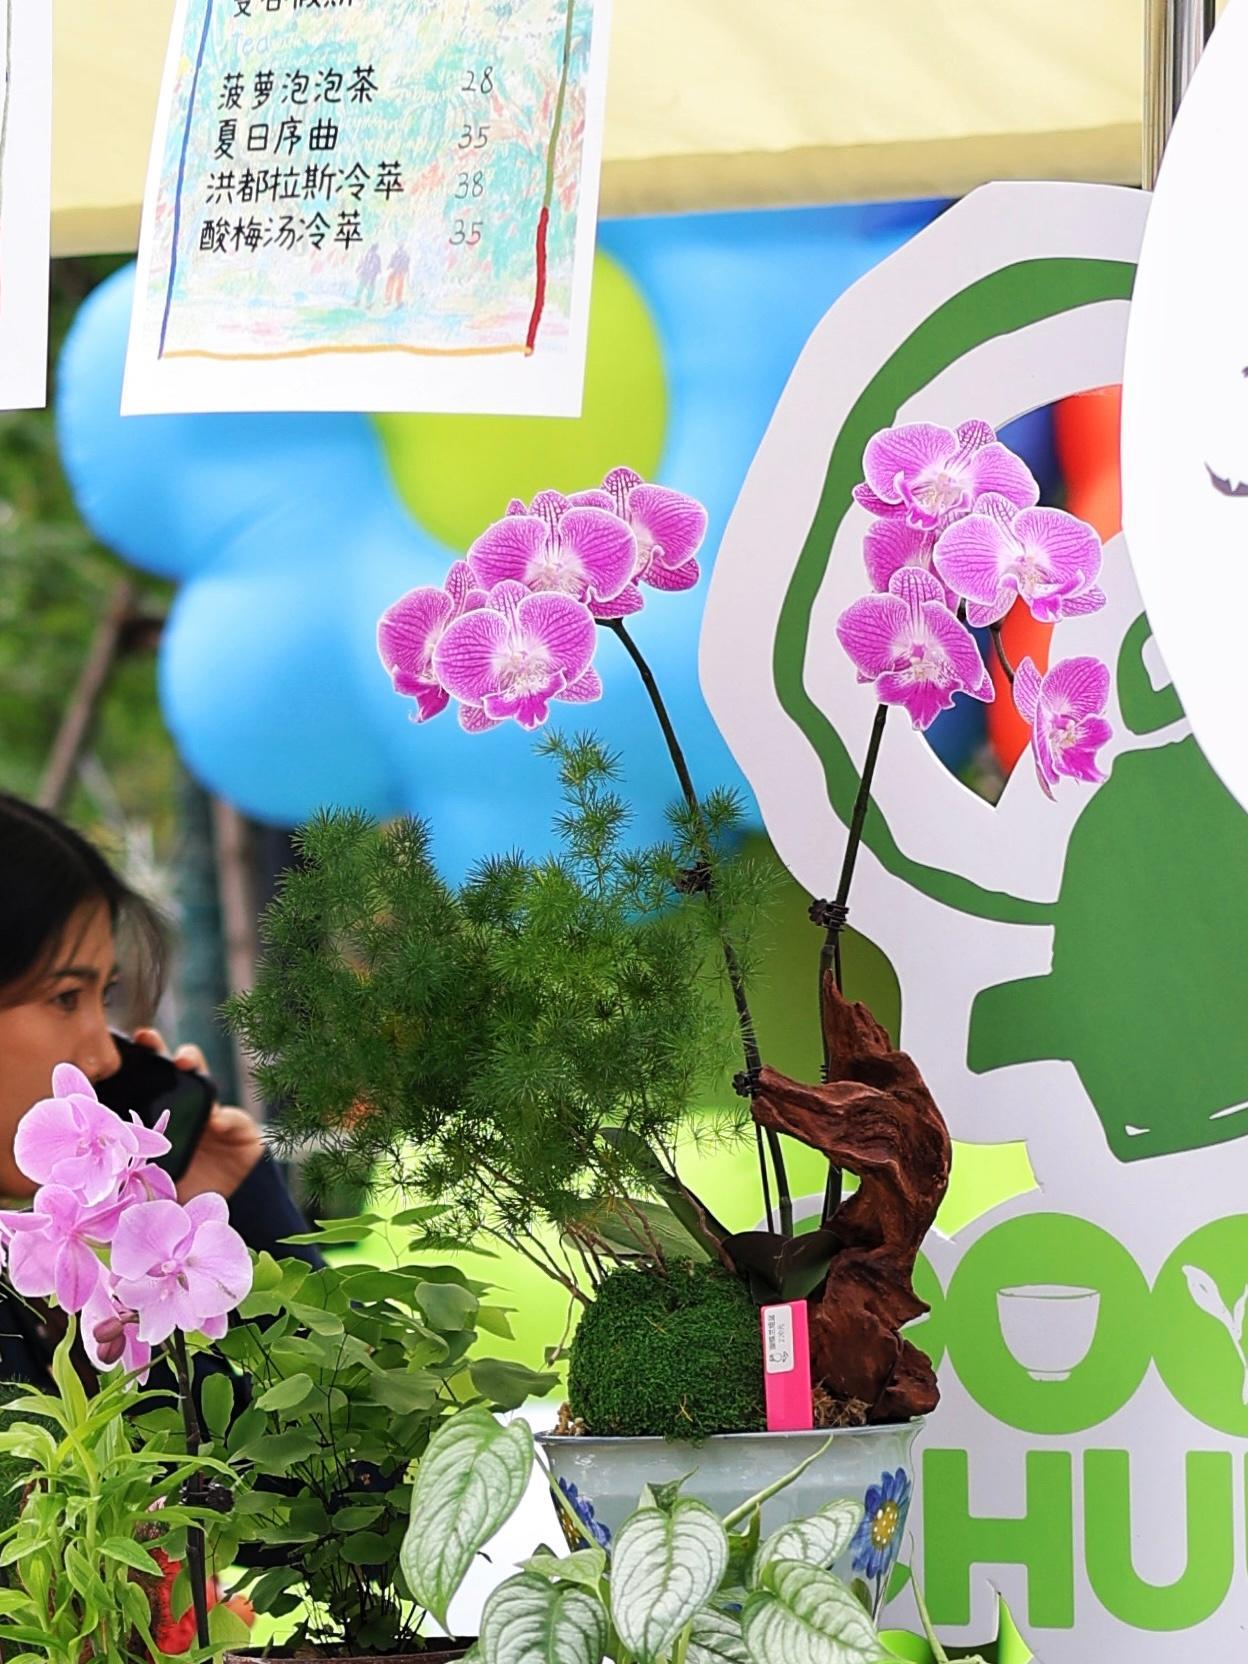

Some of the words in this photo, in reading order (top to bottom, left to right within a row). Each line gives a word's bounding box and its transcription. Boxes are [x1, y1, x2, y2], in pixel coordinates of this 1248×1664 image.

[217, 65, 378, 110] 菠萝泡泡茶
[461, 66, 494, 94] 28
[213, 115, 338, 160] 夏日序曲
[458, 125, 491, 149] 35
[206, 160, 405, 204] 洪都拉斯冷萃
[454, 171, 484, 199] 38
[200, 210, 364, 253] 酸梅汤冷萃
[449, 219, 484, 245] 35
